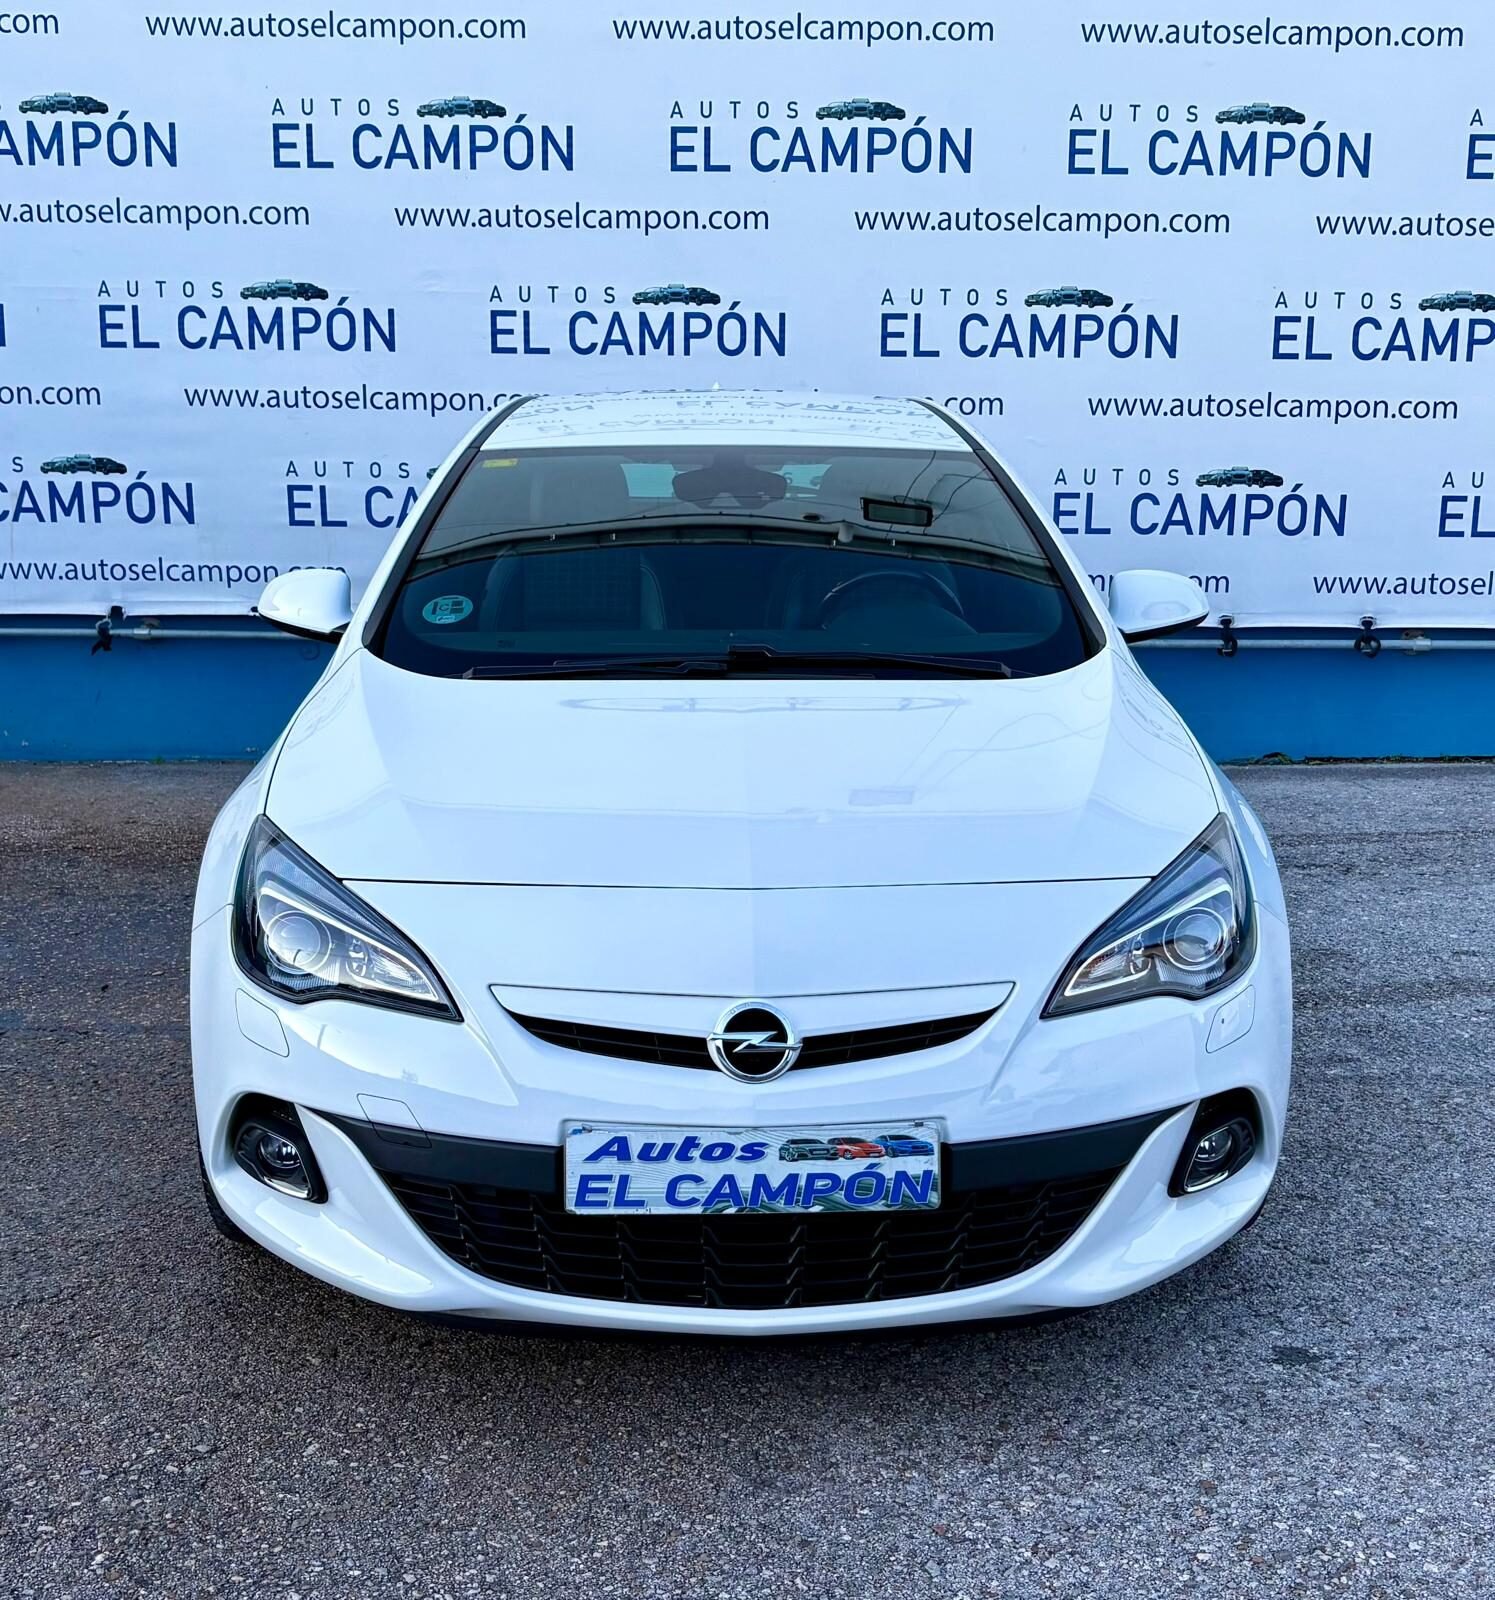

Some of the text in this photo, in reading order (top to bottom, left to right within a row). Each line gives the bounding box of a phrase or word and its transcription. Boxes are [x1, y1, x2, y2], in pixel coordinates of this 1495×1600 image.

[146, 10, 525, 45] www.autoselcampon.com
[613, 12, 993, 47] www.autoselcampon.com
[1081, 17, 1463, 53] www.autoselcampon.com
[272, 98, 399, 116] AUTOS
[670, 101, 798, 119] AUTOS
[1070, 104, 1198, 122] AUTOS
[273, 114, 573, 171] EL CAMPÓN
[671, 117, 972, 173] EL CAMPÓN
[1068, 121, 1371, 178] EL CAMPÓN
[394, 202, 768, 236] www.autoselcampon.com
[855, 205, 1229, 239] www.autoselcampon.com
[98, 280, 223, 298] AUTOS
[490, 285, 615, 303] AUTOS
[881, 288, 1007, 306] AUTOS
[1275, 291, 1401, 309] AUTOS
[99, 297, 395, 352] EL CAMPÓN
[490, 302, 785, 356] EL CAMPÓN
[881, 304, 1178, 358] EL CAMPÓN
[1272, 316, 1332, 360] EL
[1088, 392, 1457, 424] www.autoselcampon.com
[286, 461, 409, 478] AUTOS
[1054, 468, 1178, 486] AUTOS
[287, 485, 347, 527] EL
[1053, 484, 1347, 536] EL CAMPÓN
[583, 1135, 769, 1163] Autos
[574, 1162, 934, 1209] EL CAMPÓN
